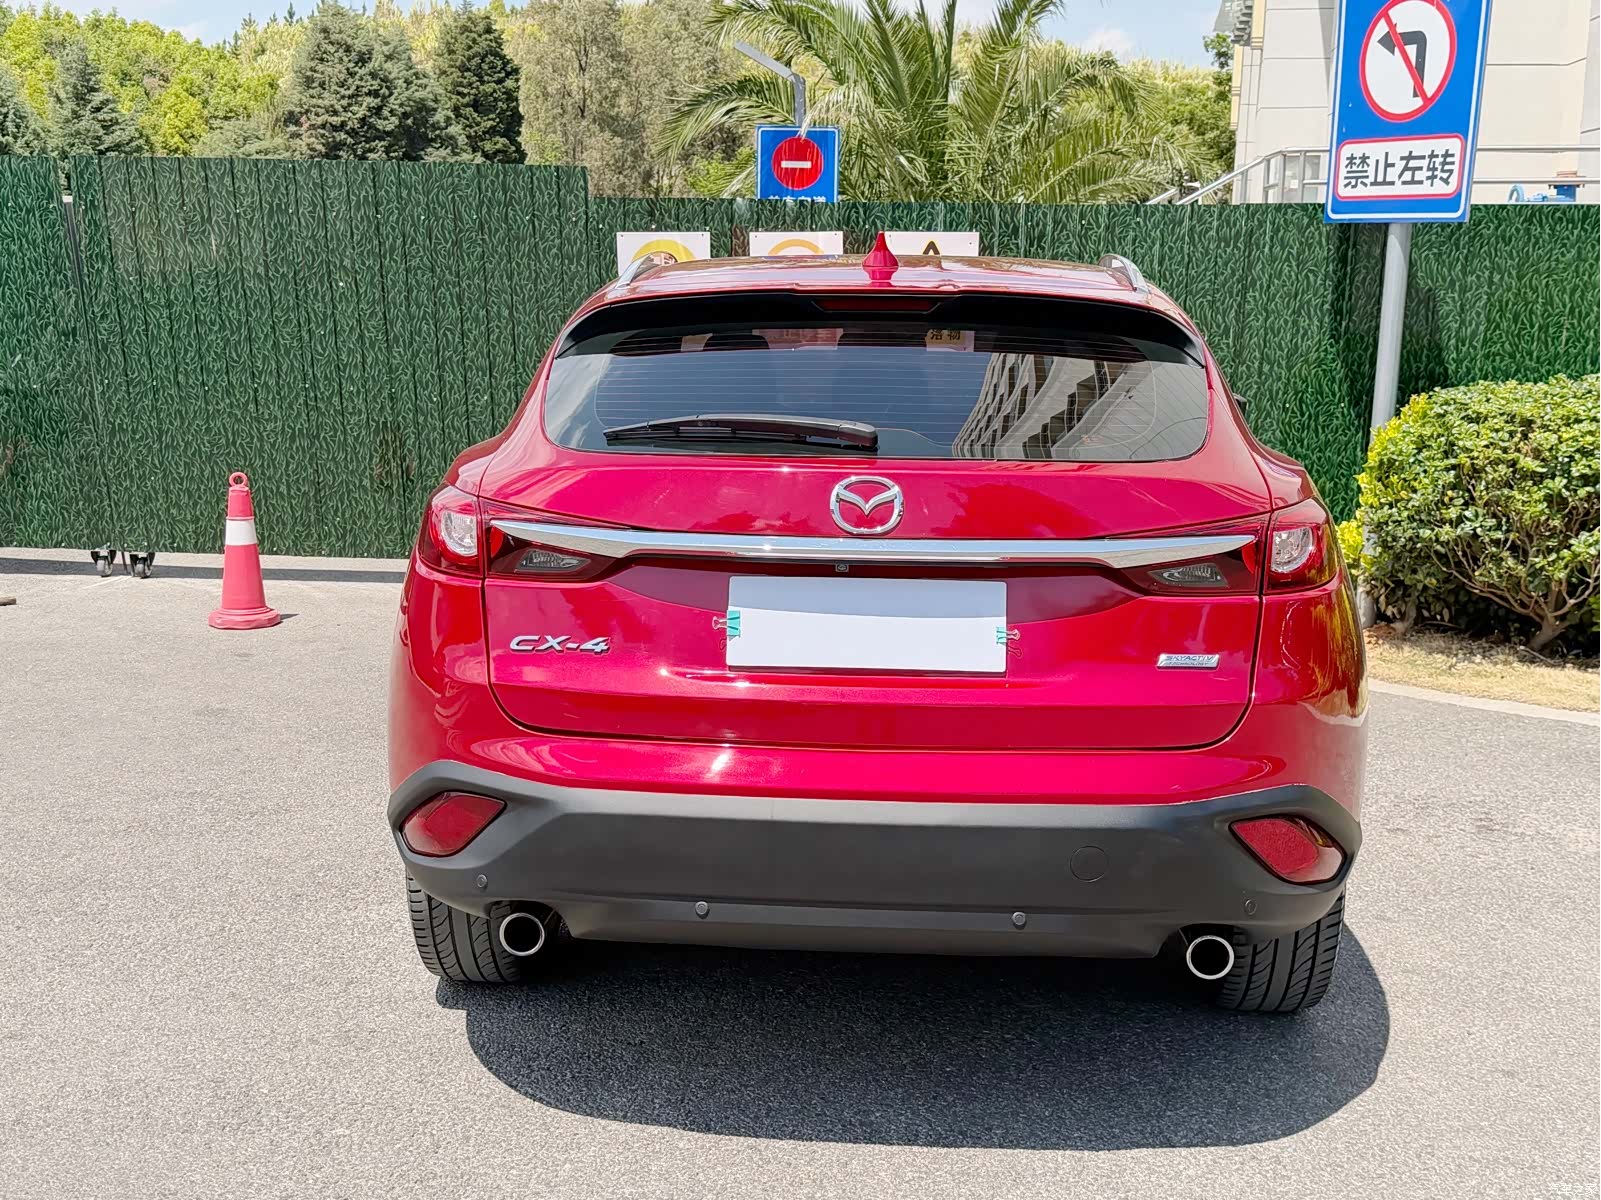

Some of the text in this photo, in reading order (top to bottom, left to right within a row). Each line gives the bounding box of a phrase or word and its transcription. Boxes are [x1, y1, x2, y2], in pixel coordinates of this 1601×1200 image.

[1343, 148, 1455, 189] 禁止左转
[509, 635, 611, 655] CX-4
